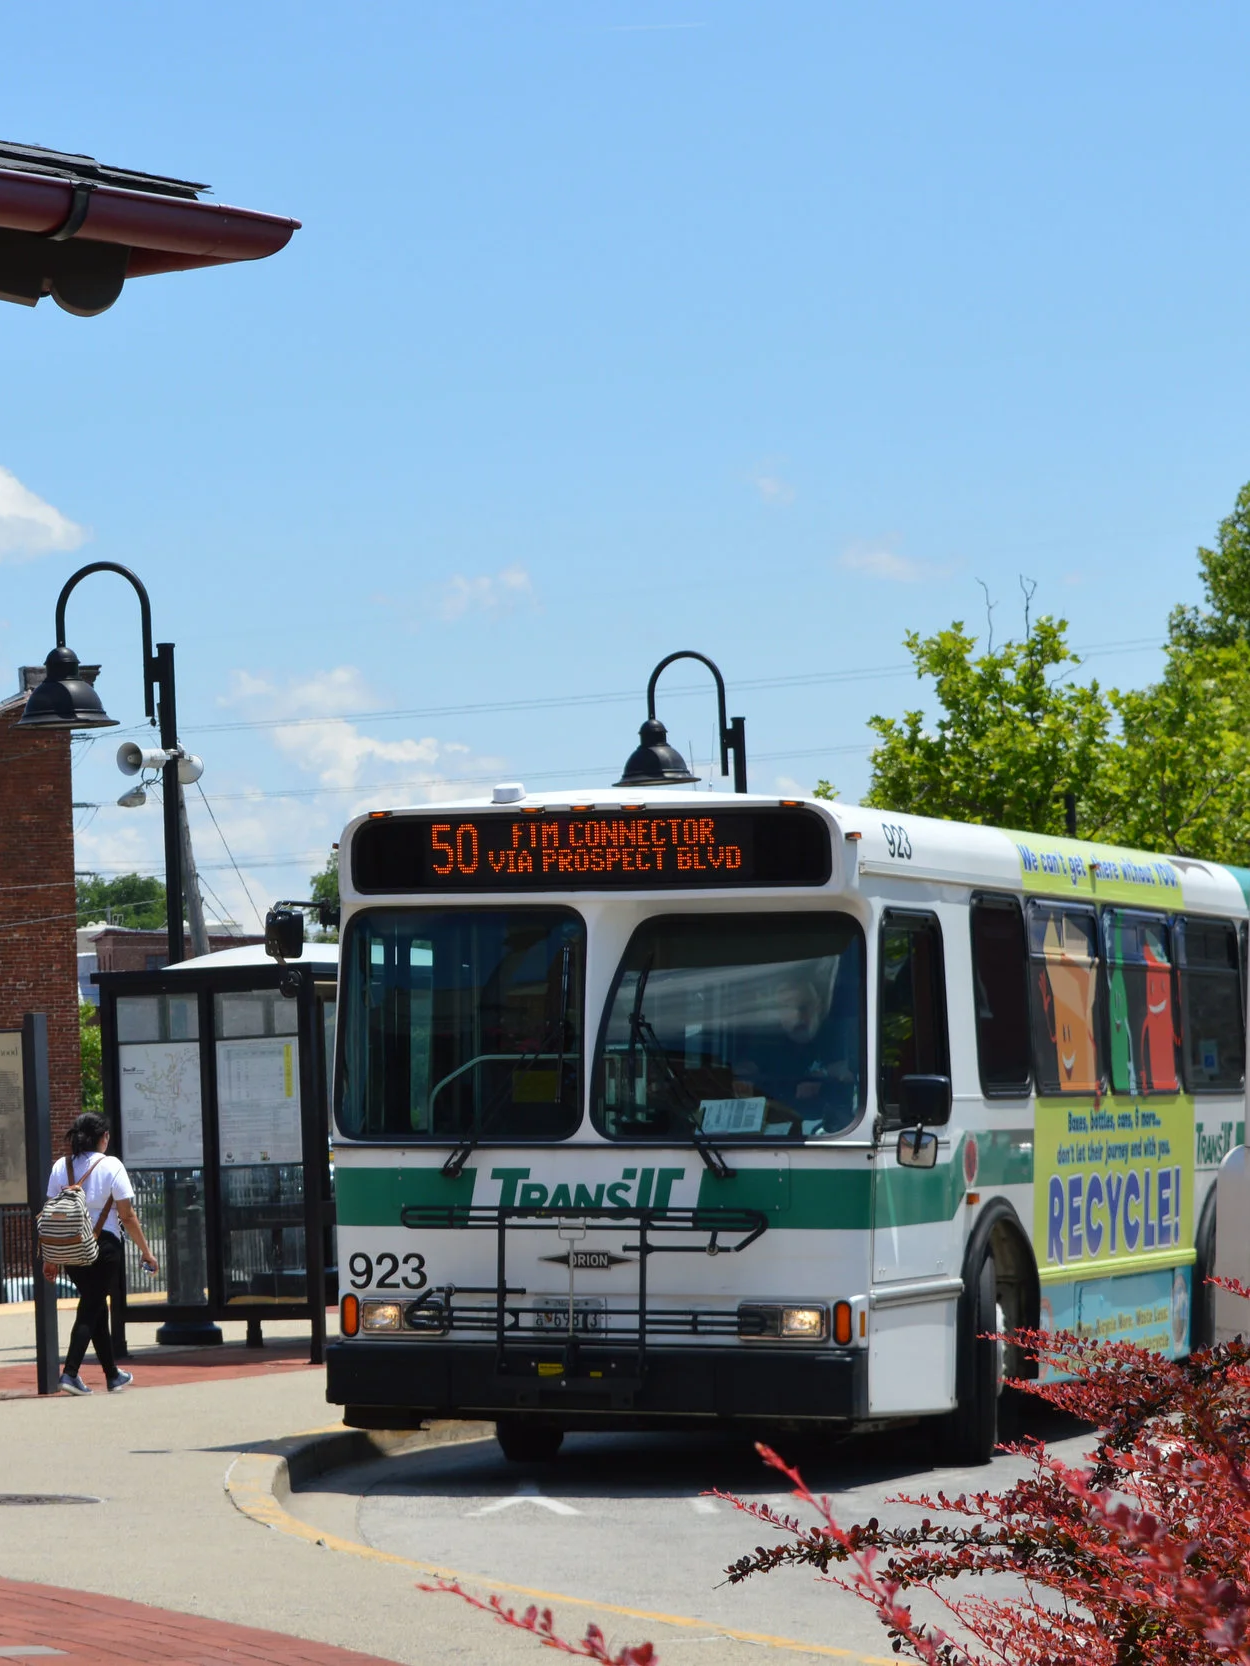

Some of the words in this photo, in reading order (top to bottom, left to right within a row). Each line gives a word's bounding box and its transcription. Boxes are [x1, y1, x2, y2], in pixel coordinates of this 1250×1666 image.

[431, 823, 478, 874] 50
[568, 819, 715, 847] CONNECTOR
[882, 822, 912, 860] 923
[488, 850, 533, 872] VIA
[542, 847, 666, 872] PROSPECT
[677, 846, 742, 869] BLVD
[1016, 843, 1038, 872] We
[1040, 851, 1067, 876] can't
[1068, 855, 1087, 887] get
[1047, 1166, 1180, 1268] RECYCLE!
[349, 1252, 427, 1289] 923
